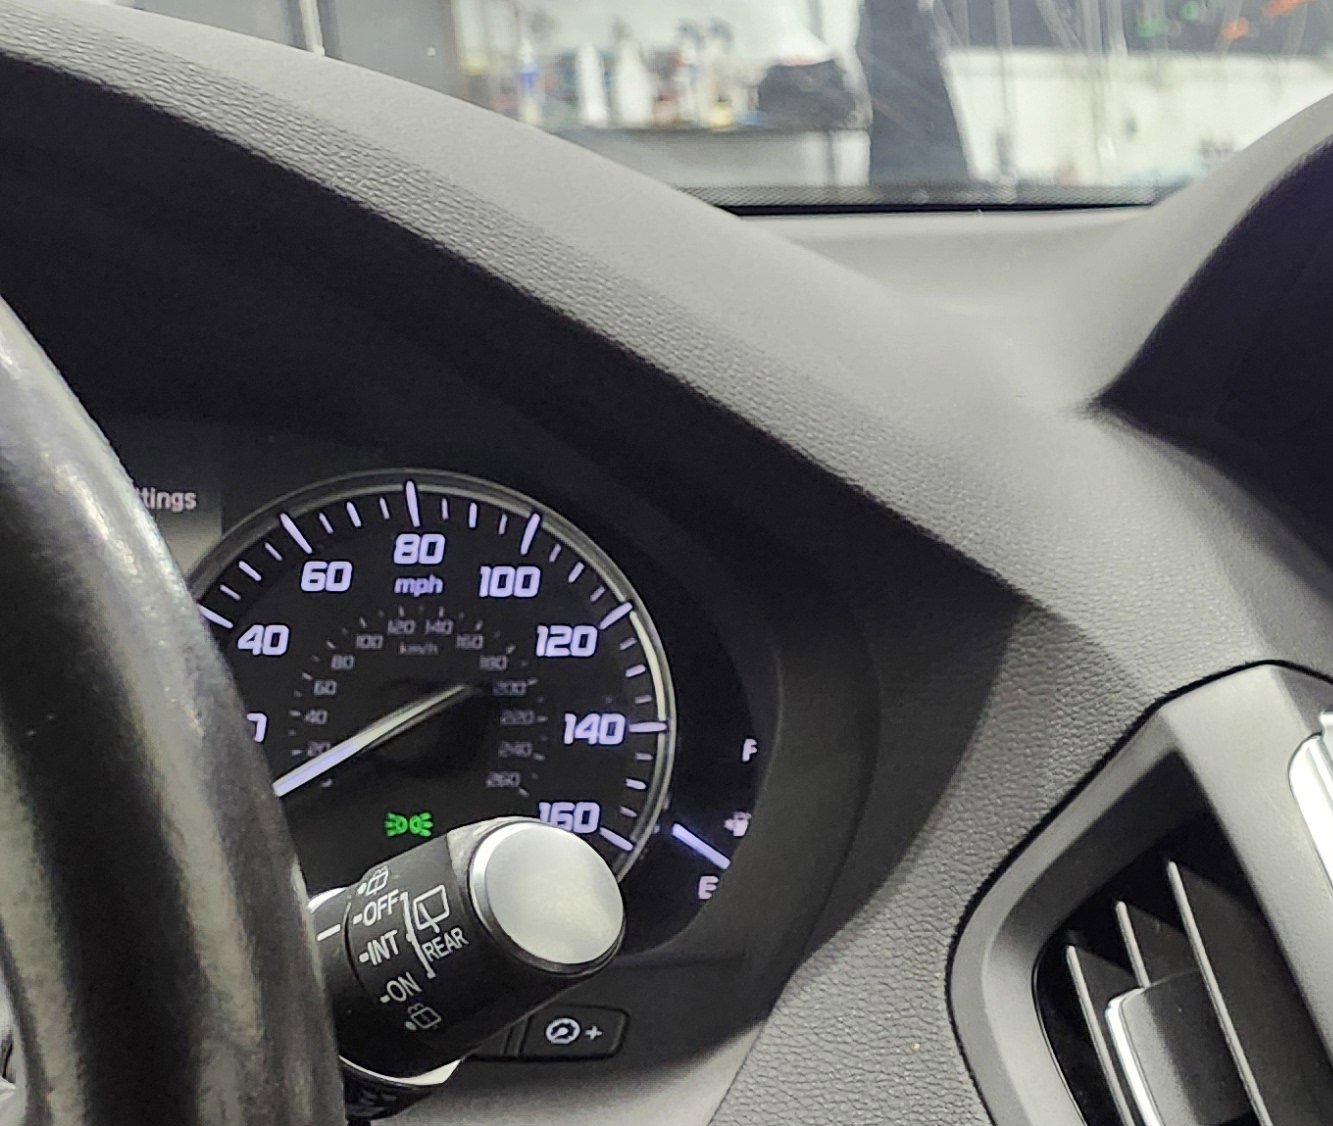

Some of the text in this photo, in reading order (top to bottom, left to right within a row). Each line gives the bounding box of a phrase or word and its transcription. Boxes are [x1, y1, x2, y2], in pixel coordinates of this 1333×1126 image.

[137, 487, 197, 513] tings
[393, 533, 446, 565] 80
[301, 561, 352, 591] 60
[394, 574, 443, 597] mph
[479, 565, 541, 598] 100
[387, 619, 416, 634] 120
[425, 619, 454, 634] 140
[238, 625, 289, 656] 40
[356, 635, 383, 649] 100
[456, 635, 484, 649] 160
[535, 625, 598, 657] 120
[331, 655, 355, 670] 80
[314, 680, 337, 695] 60
[304, 710, 328, 724] 40
[563, 713, 626, 745] 140
[742, 738, 758, 762] F
[538, 802, 600, 834] 160
[698, 876, 719, 900] E
[363, 889, 399, 926] OFF
[368, 930, 398, 965] INT
[422, 928, 469, 962] REAR
[387, 972, 422, 1001] ON
